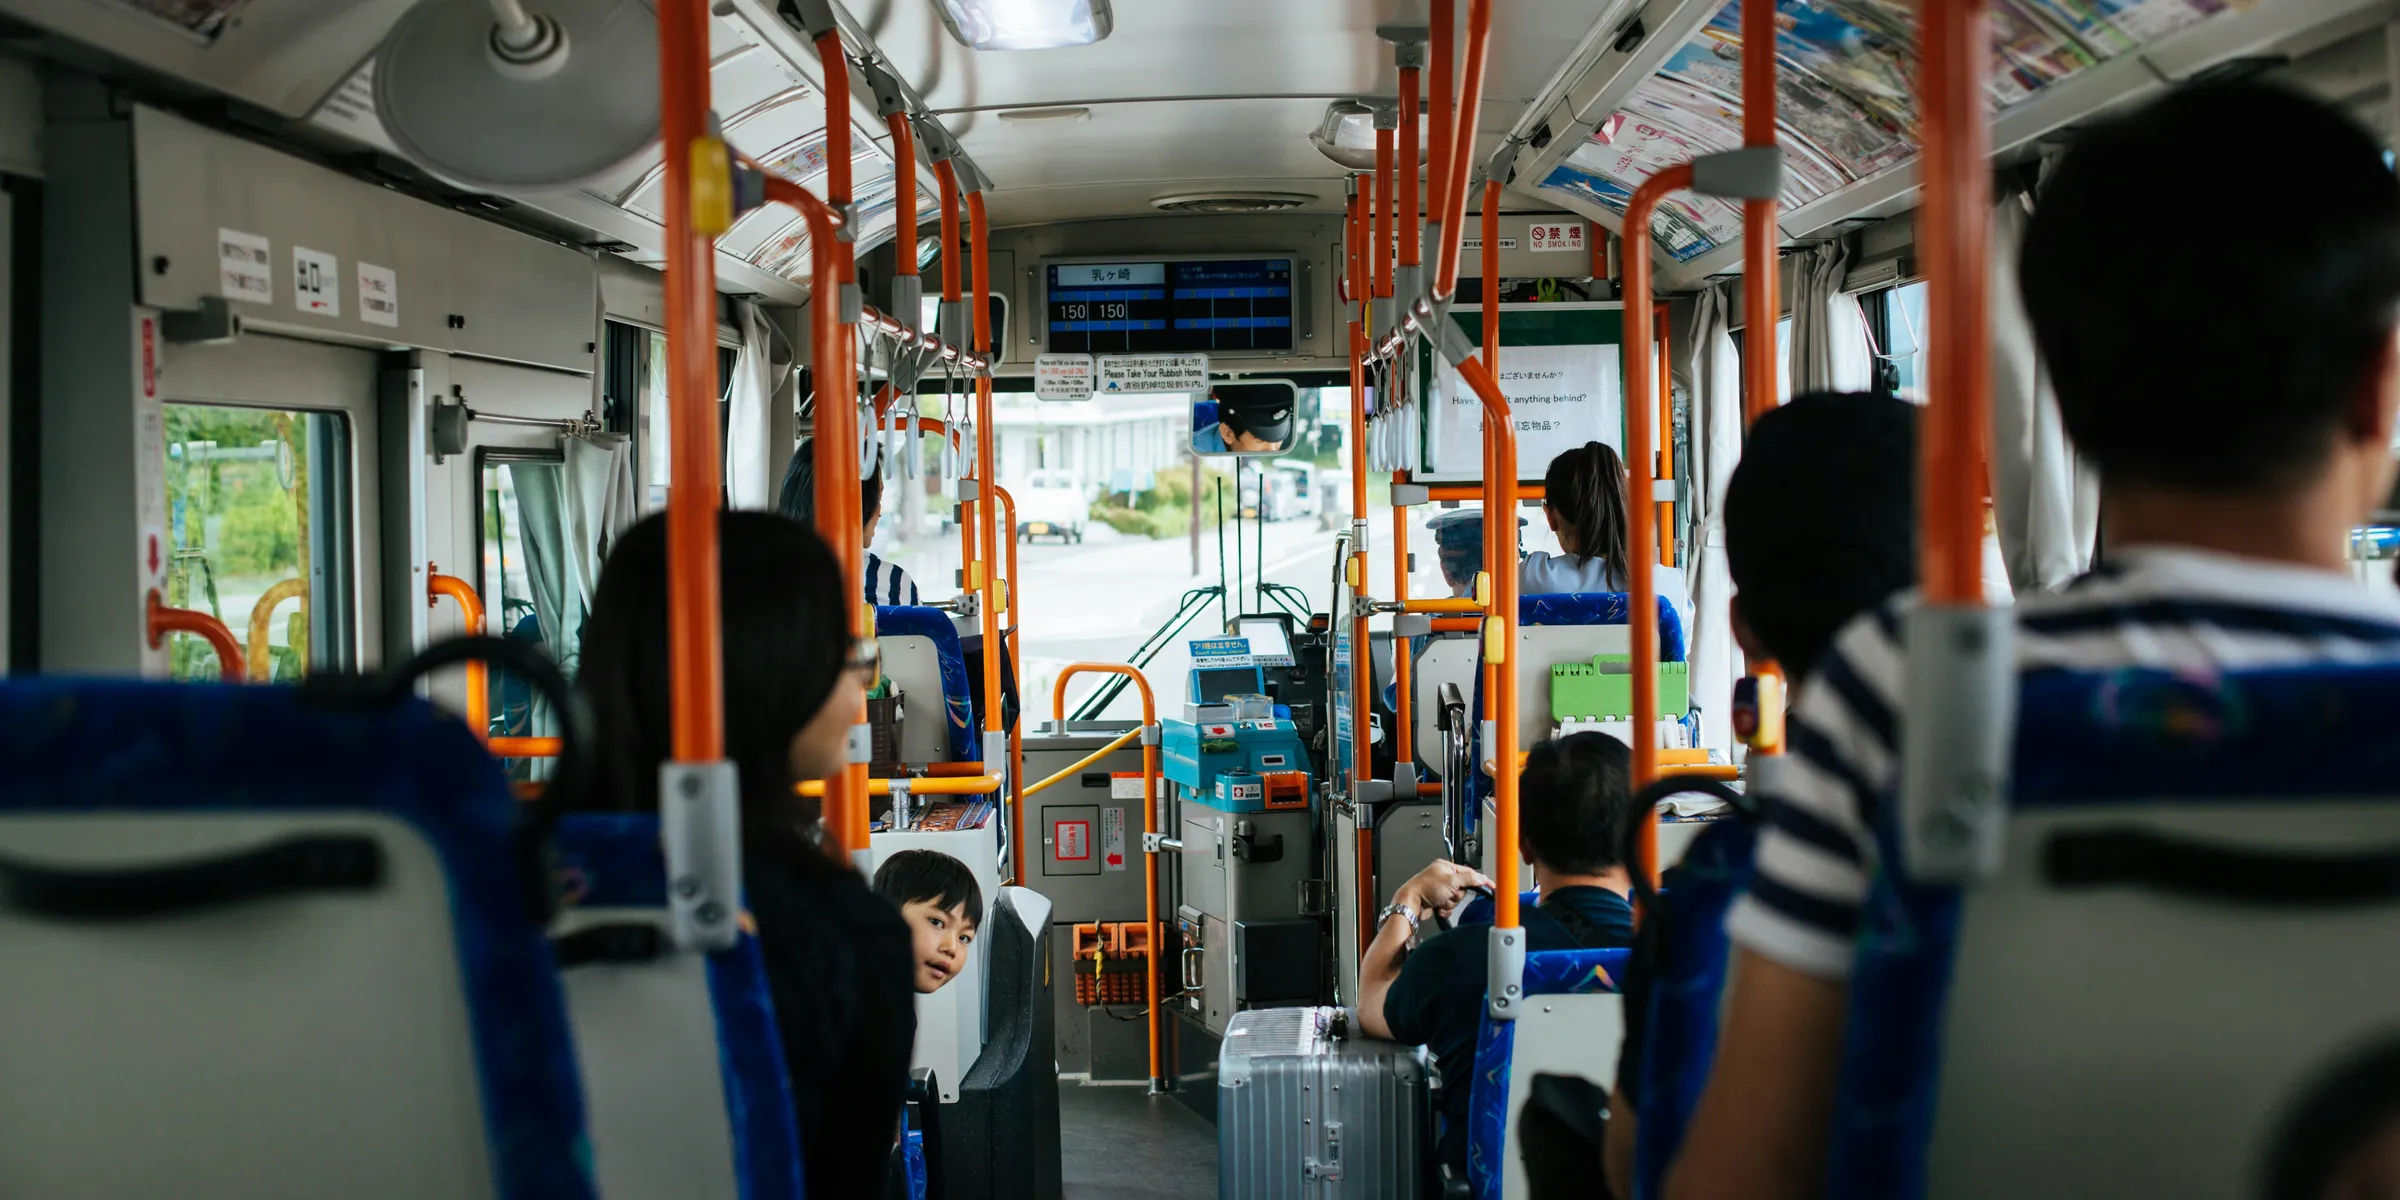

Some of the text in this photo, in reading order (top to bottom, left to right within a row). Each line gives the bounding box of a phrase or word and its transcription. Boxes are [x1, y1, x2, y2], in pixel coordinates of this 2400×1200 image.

[1548, 240, 1582, 248] SMOKING
[296, 259, 320, 294] 出口
[1060, 303, 1125, 319] 150 150
[1104, 368, 1203, 378] Please Take Your Rubbish Home.
[1452, 396, 1475, 405] Have
[1514, 394, 1551, 405] anything
[1553, 393, 1587, 403] behind?
